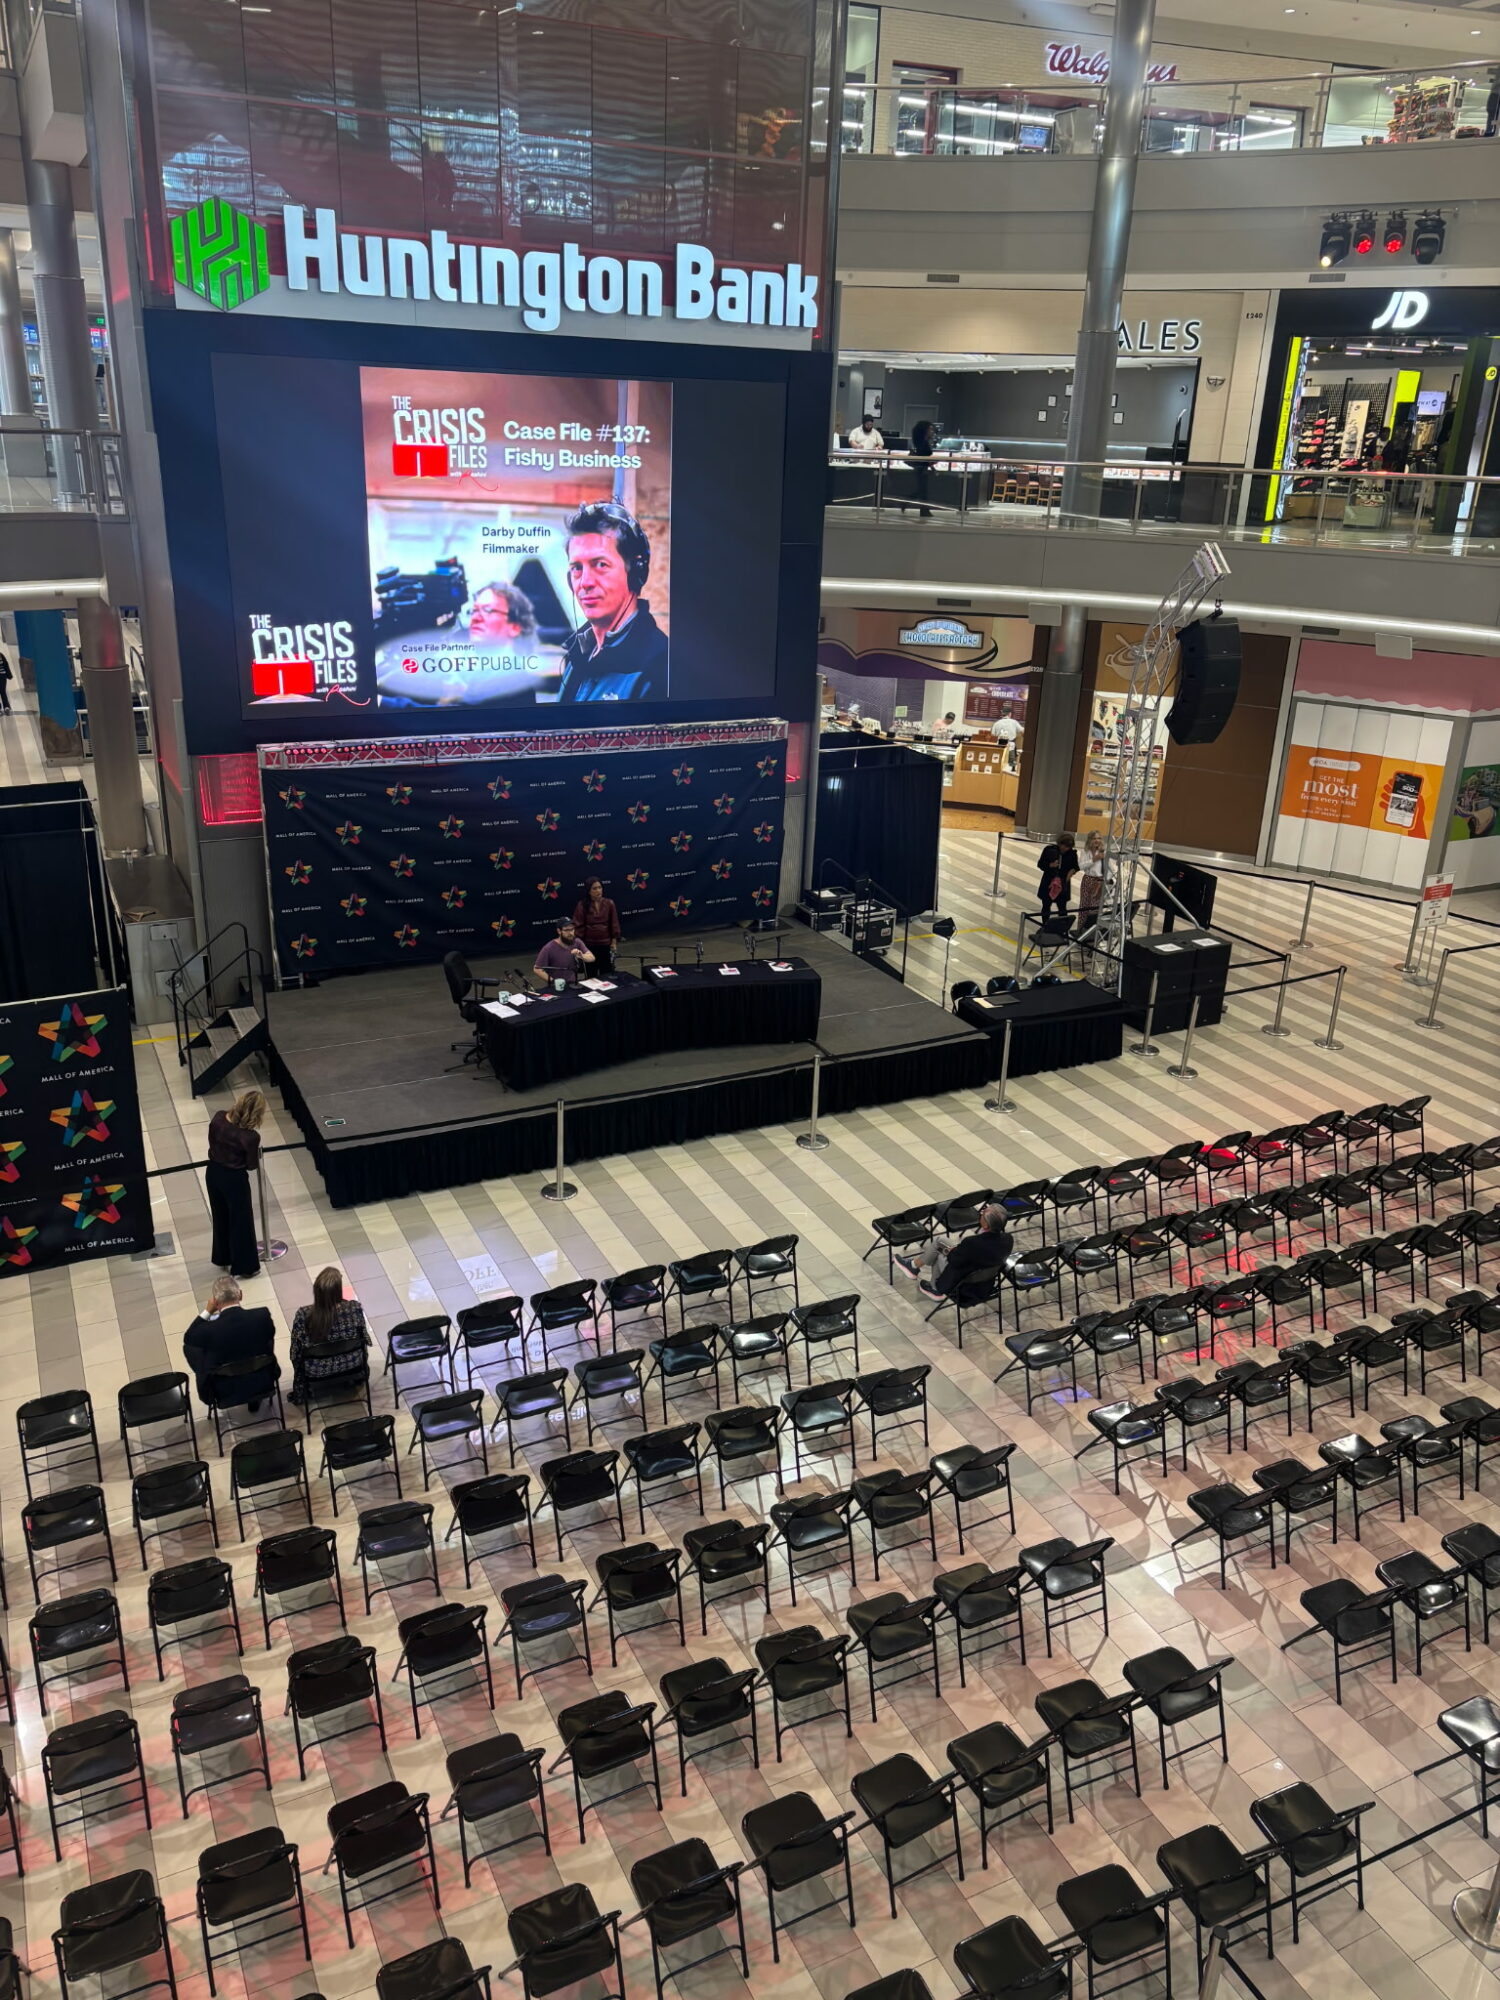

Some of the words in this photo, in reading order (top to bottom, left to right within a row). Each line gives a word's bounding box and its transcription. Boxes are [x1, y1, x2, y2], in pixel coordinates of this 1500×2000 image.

[1047, 42, 1180, 84] Walgns
[283, 204, 663, 333] Huntington
[675, 242, 819, 329] Bank
[1371, 291, 1430, 330] JD
[1118, 321, 1201, 351] ALES
[392, 396, 412, 410] THE
[392, 407, 487, 446] CRISIS
[503, 420, 556, 441] Case
[560, 423, 592, 442] File
[596, 424, 650, 444] #137:
[449, 445, 488, 470] FILES
[504, 448, 554, 471] Fishy
[558, 450, 642, 469] Business
[482, 526, 515, 539] Darby
[518, 526, 551, 538] Duffin
[482, 544, 539, 554] Filmmaker
[249, 614, 272, 629] THE
[252, 620, 355, 664] CRISIS
[402, 644, 423, 653] Case
[425, 644, 440, 652] File
[441, 643, 476, 652] Partner:
[314, 659, 358, 684] FILES
[1303, 780, 1360, 800] most
[41, 1074, 62, 1083] MALL
[79, 1065, 115, 1077] AMERICA
[0, 1108, 24, 1117] ERICA
[54, 1162, 74, 1171] MALL
[89, 1152, 125, 1164] AMERICA
[64, 1244, 85, 1252] MALL
[100, 1237, 135, 1247] AMERICA
